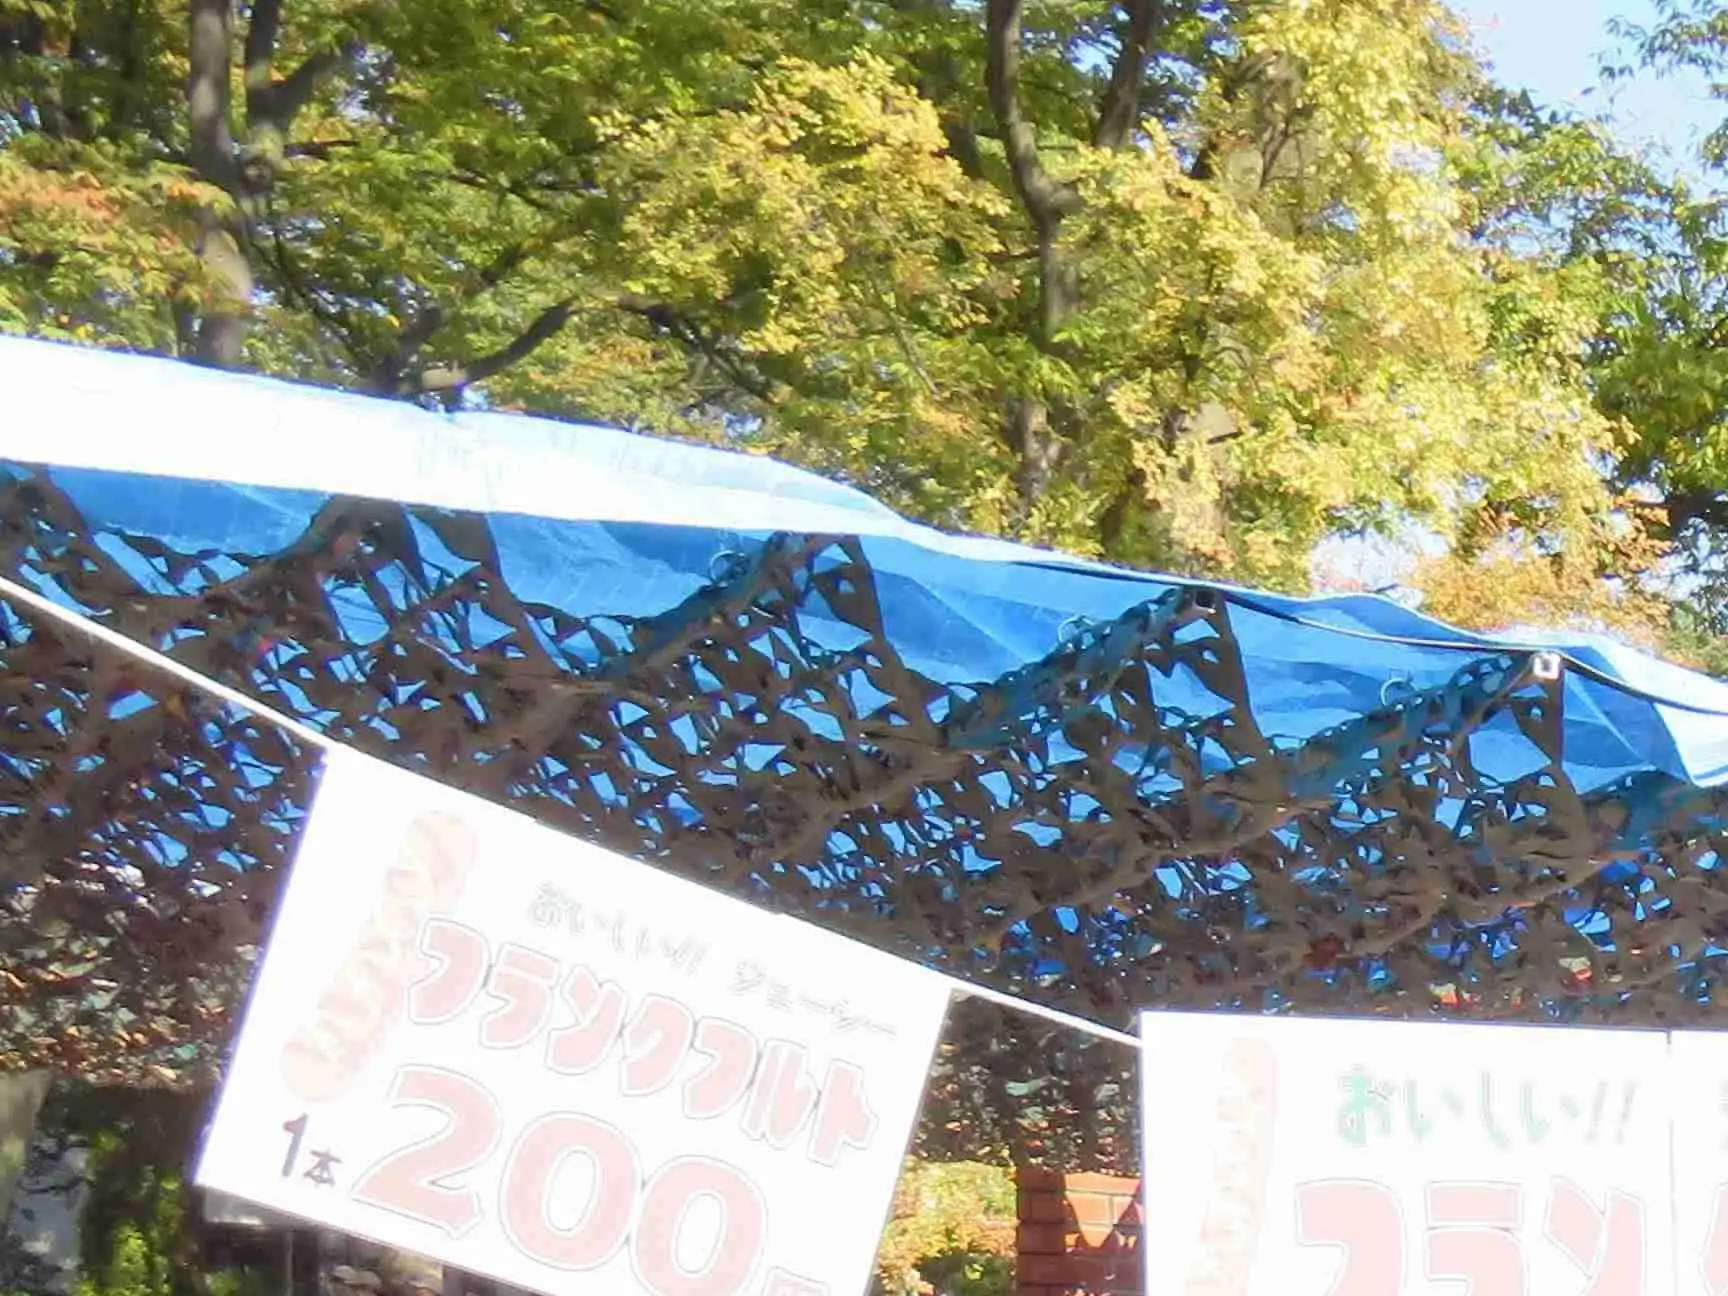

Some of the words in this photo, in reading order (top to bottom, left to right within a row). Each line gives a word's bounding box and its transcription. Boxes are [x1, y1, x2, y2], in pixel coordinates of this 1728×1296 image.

[407, 917, 879, 1168] フランクフルト
